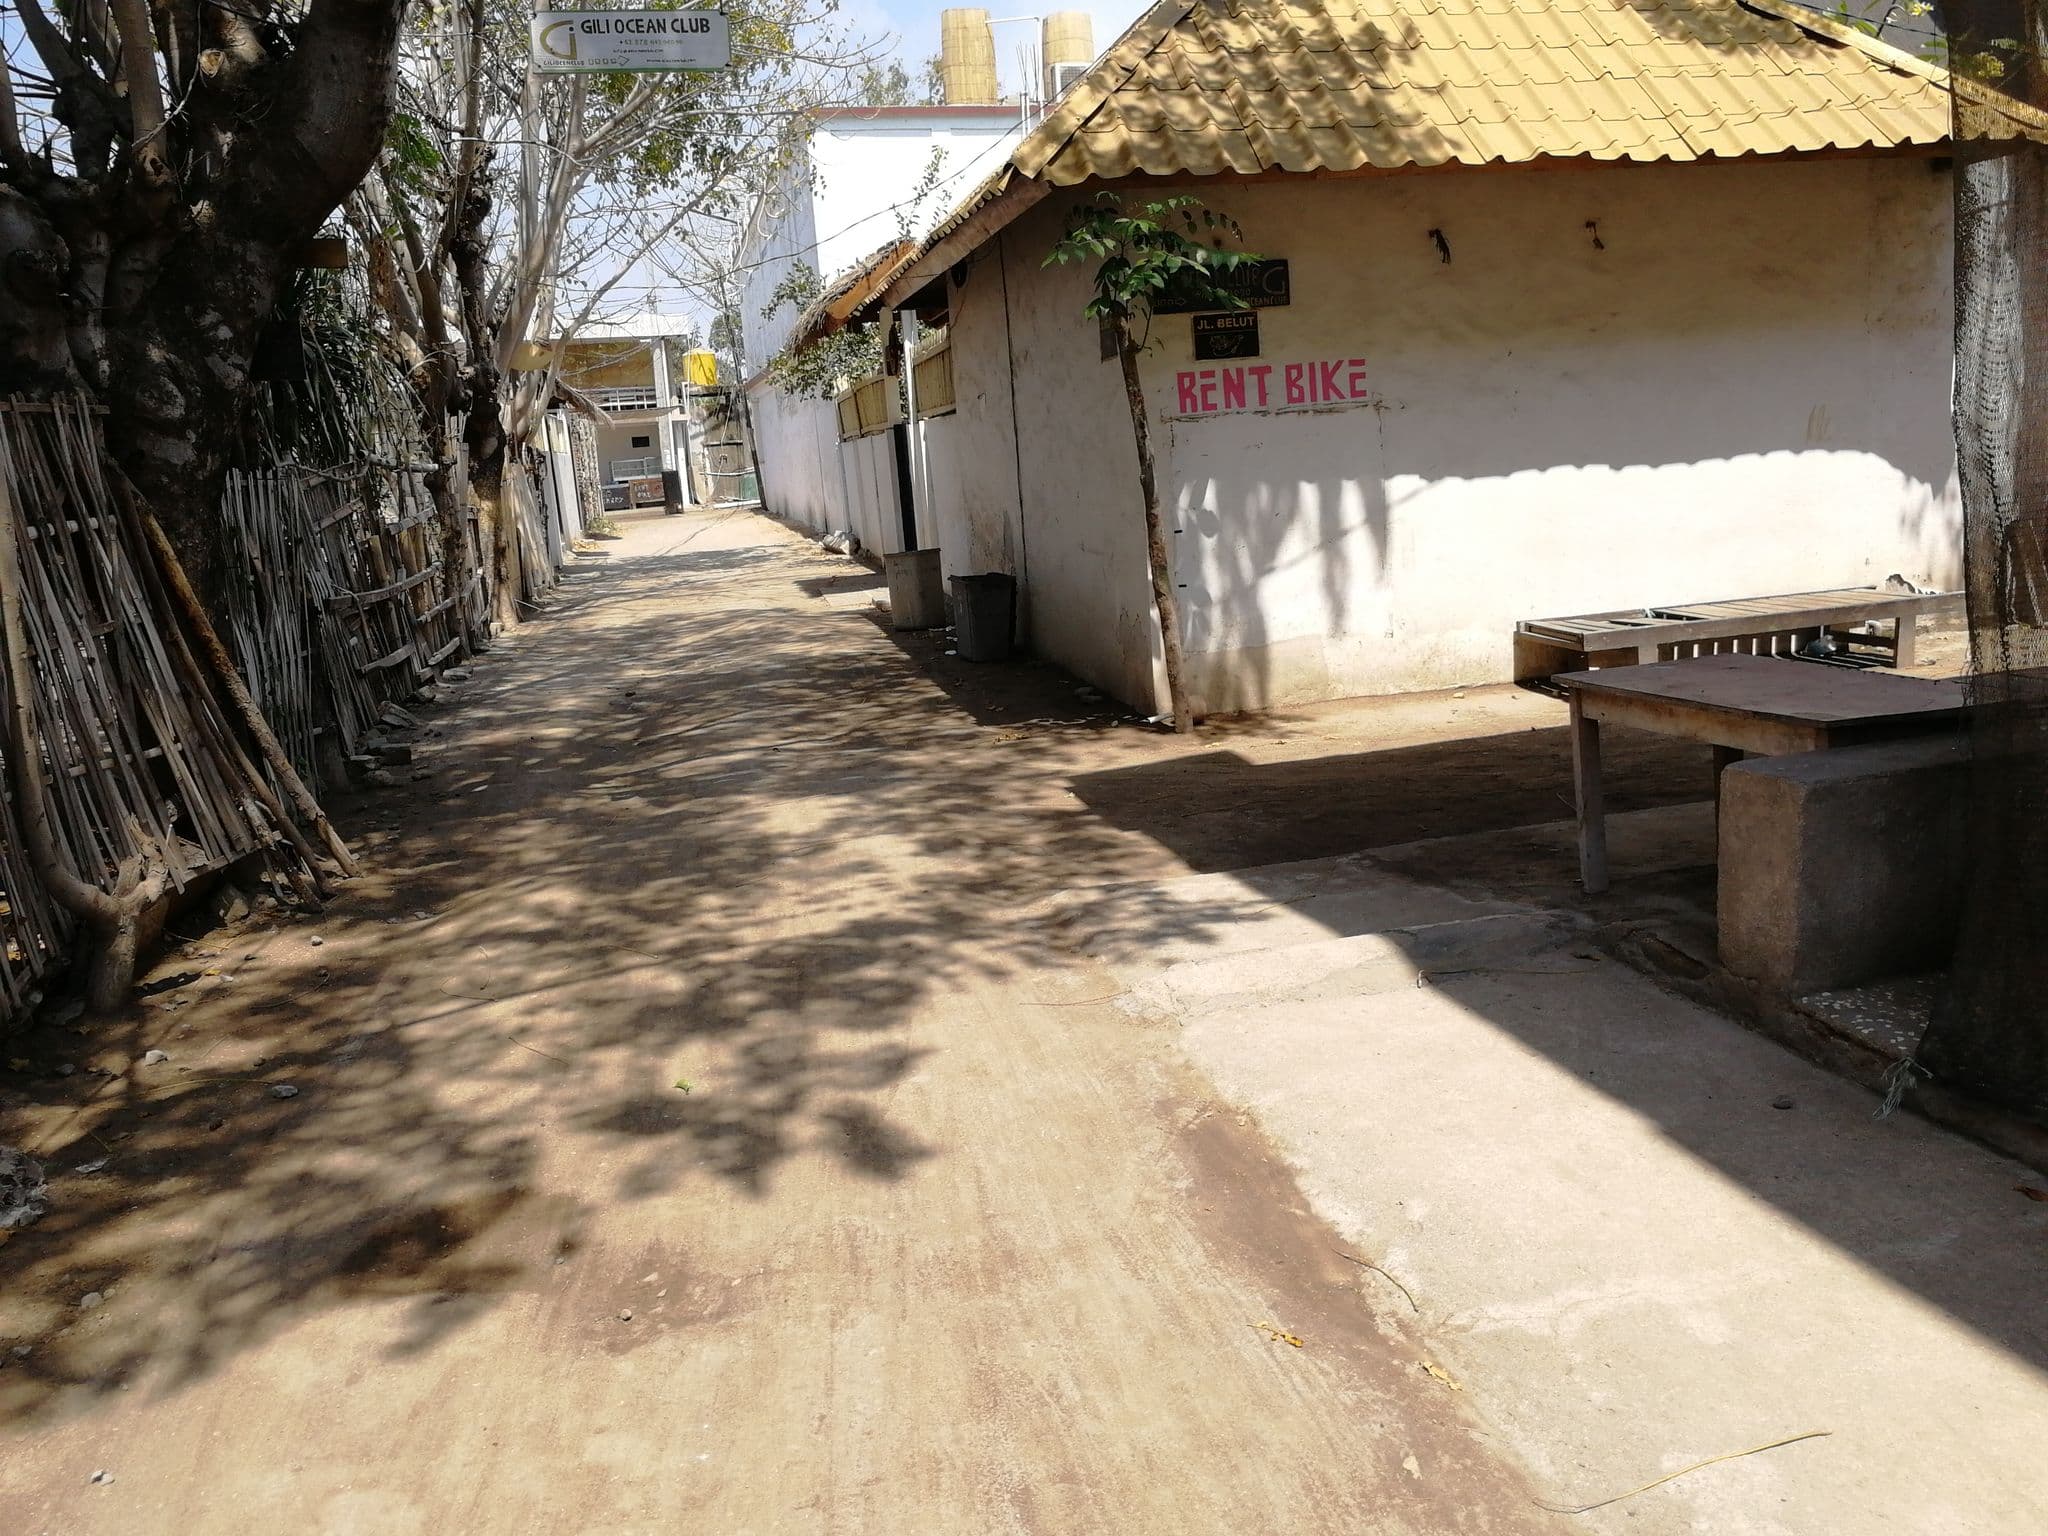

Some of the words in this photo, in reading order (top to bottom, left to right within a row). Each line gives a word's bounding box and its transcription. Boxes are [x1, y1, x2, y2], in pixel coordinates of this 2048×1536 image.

[581, 19, 611, 34] GILI
[614, 18, 667, 34] OCEAN
[671, 17, 711, 34] CLUB
[1197, 320, 1214, 330] JL.
[1217, 317, 1255, 329] BELUT
[1176, 365, 1273, 414] RENT
[1284, 358, 1368, 405] BIKE
